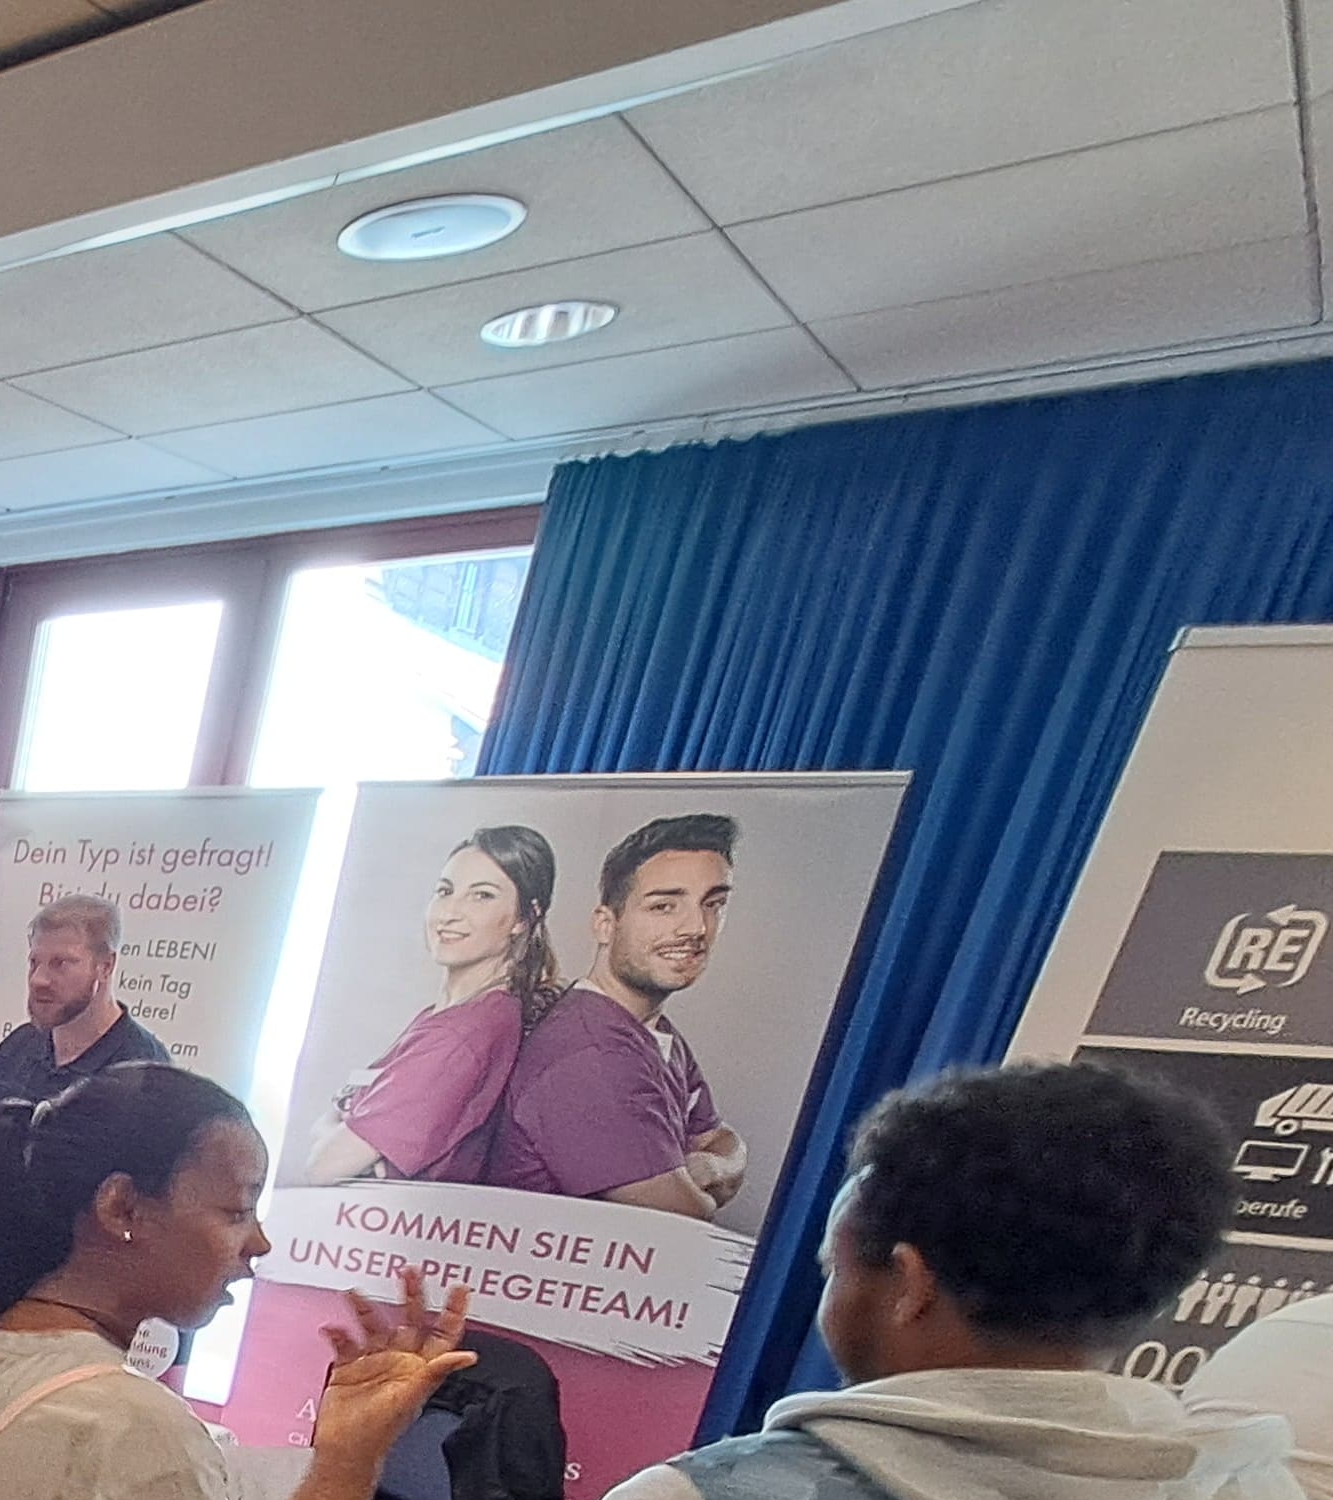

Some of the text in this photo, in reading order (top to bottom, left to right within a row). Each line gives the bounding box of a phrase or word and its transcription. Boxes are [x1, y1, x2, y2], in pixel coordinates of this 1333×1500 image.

[13, 837, 275, 875] Dein Typ ist gefragt!
[129, 882, 224, 914] dabei?
[147, 938, 217, 962] LEBEN!
[1227, 927, 1311, 973] RE
[118, 970, 193, 1000] kein Tag
[130, 998, 177, 1021] dere!
[1179, 1007, 1287, 1036] Recycling
[335, 1202, 656, 1275] KOMMEN SIE IN
[289, 1238, 690, 1330] UNSER PFLEGETEAM!
